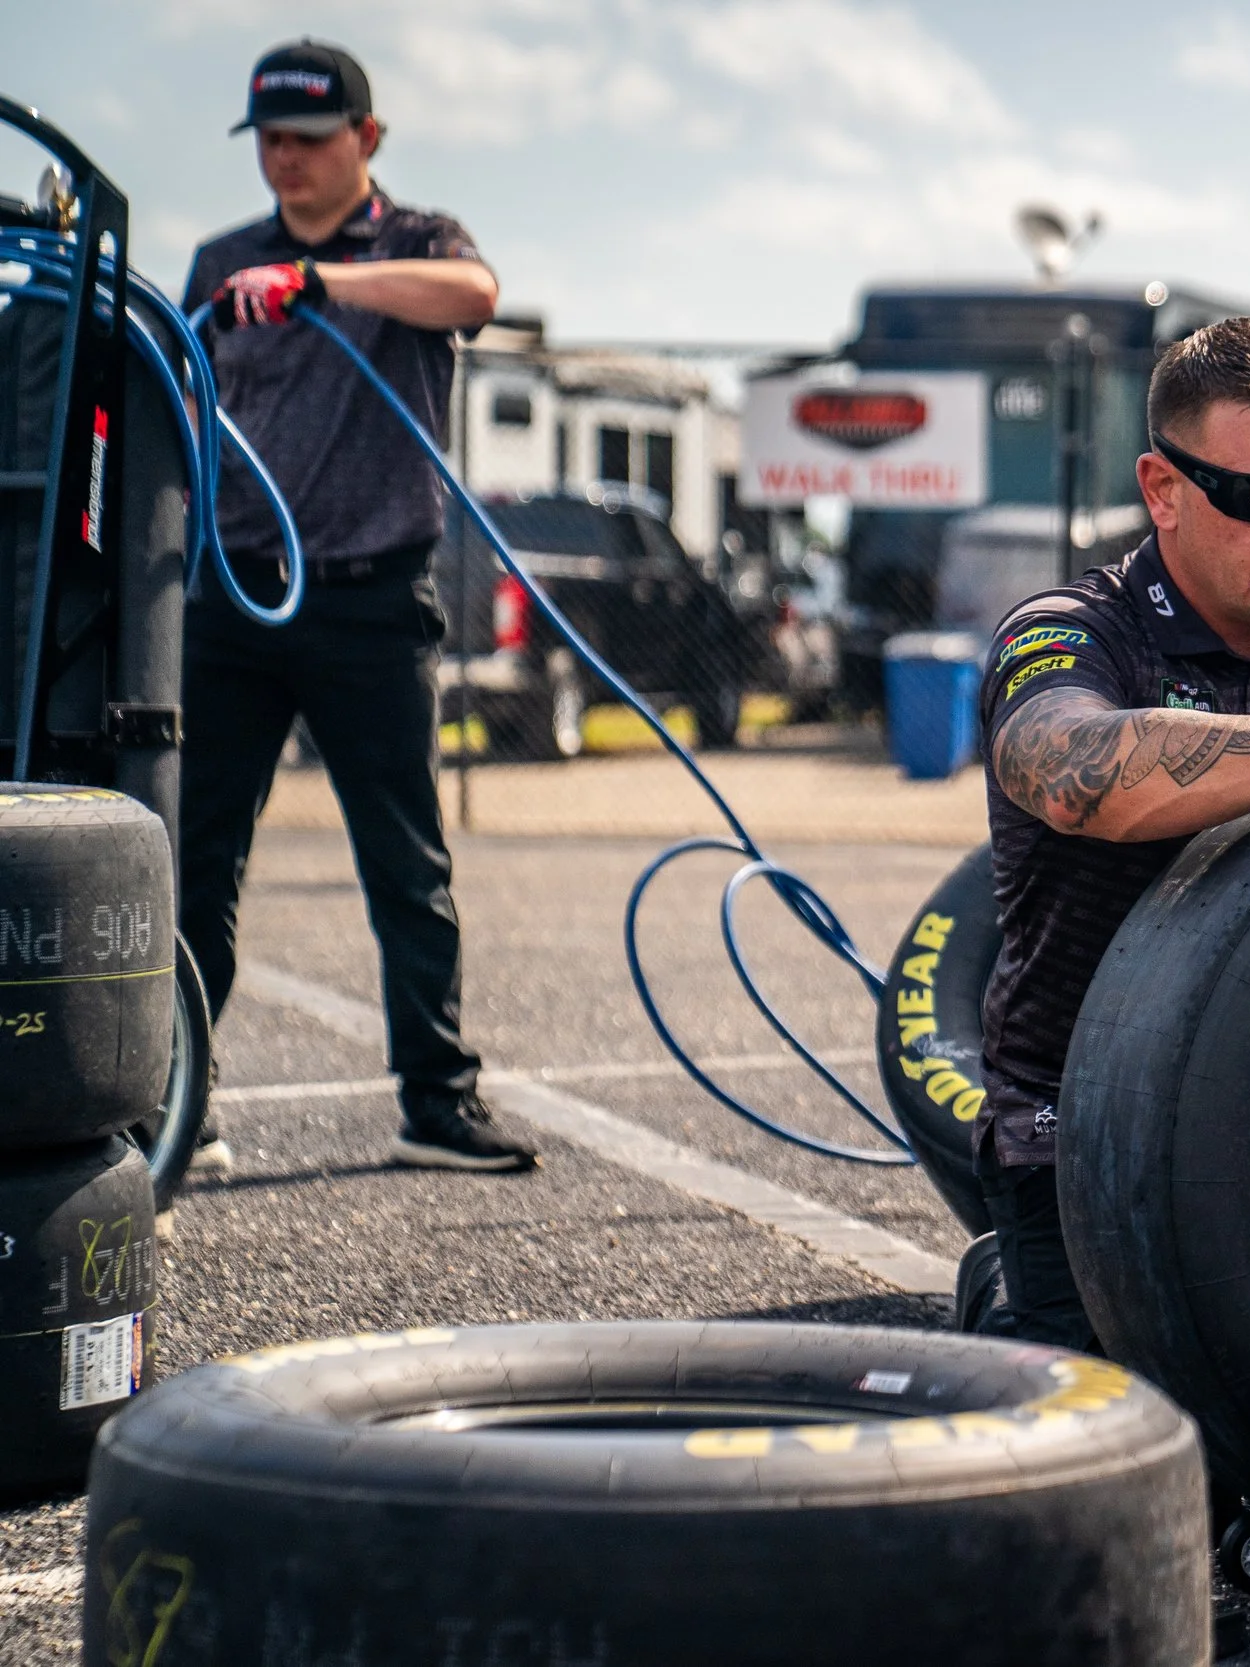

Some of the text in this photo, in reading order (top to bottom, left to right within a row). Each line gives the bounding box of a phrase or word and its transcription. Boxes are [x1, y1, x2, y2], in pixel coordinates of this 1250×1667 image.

[1147, 582, 1174, 617] 87
[998, 628, 1089, 668] SUNOCO
[0, 1011, 47, 1037] -25
[79, 1215, 132, 1297] 87
